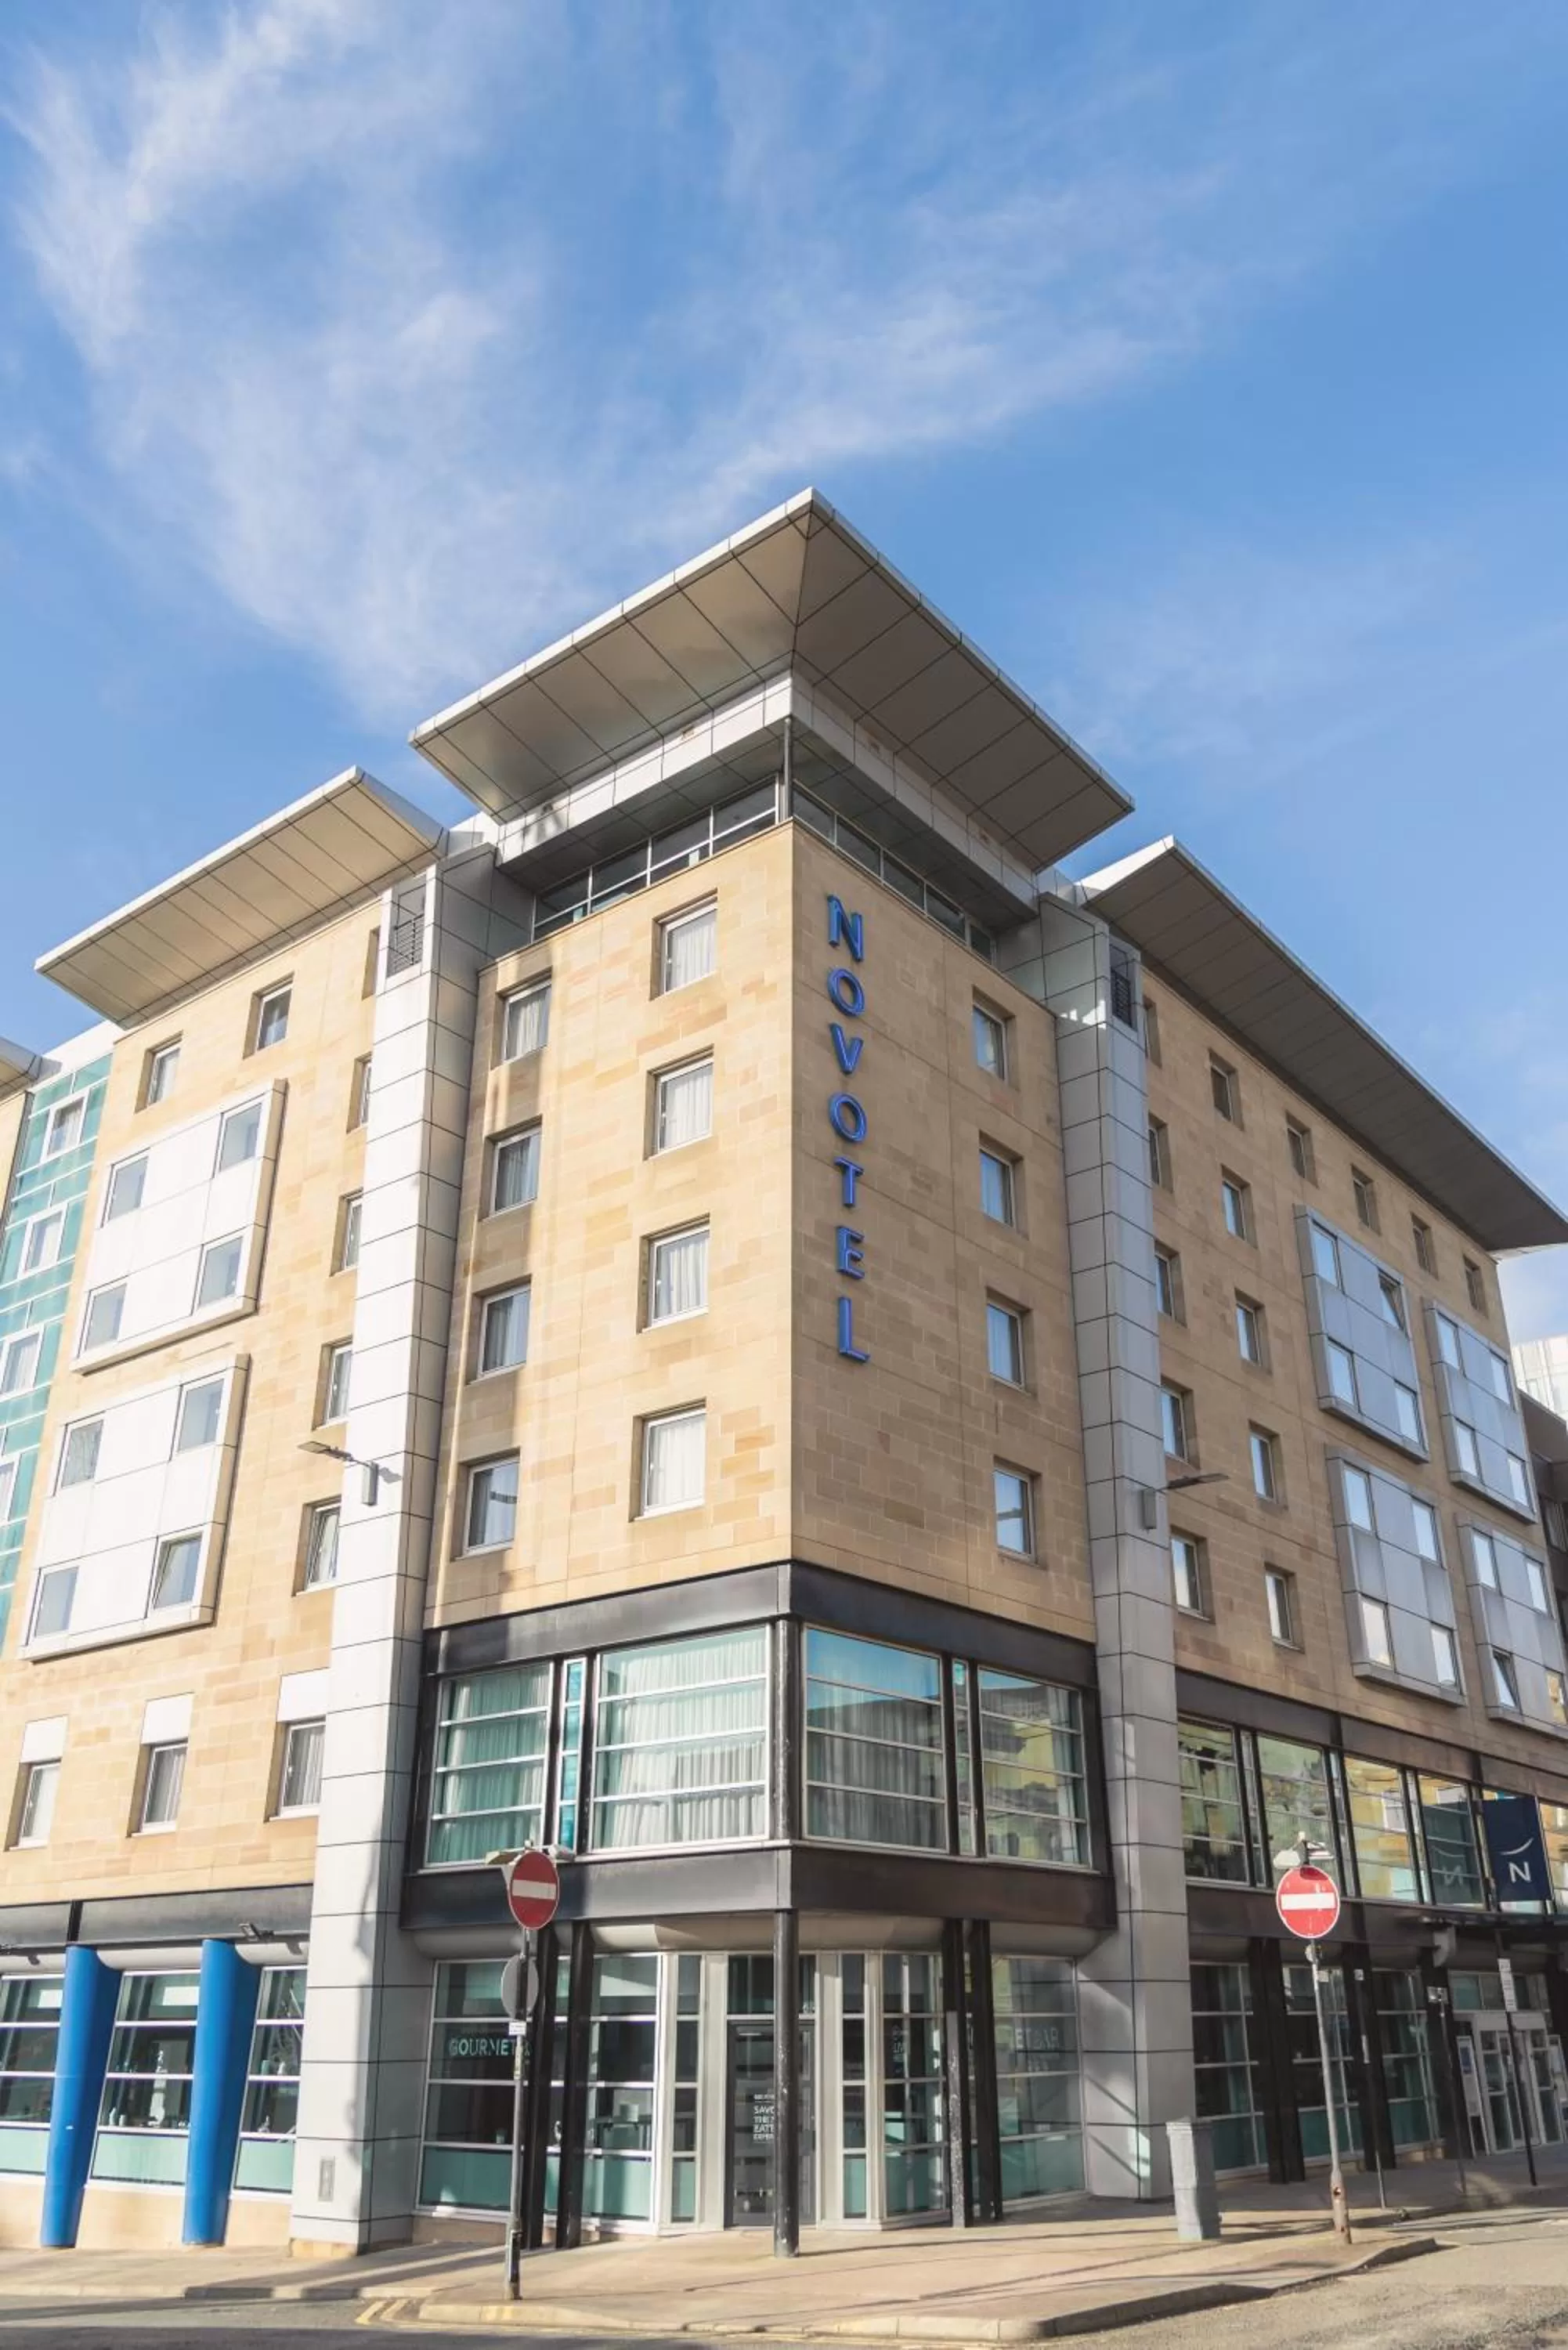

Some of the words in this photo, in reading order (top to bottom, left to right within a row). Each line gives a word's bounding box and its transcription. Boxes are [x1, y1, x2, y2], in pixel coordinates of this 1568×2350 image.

[826, 895, 870, 1363] NOVOTEL
[1508, 1861, 1531, 1882] N
[449, 2038, 517, 2055] GOURMET
